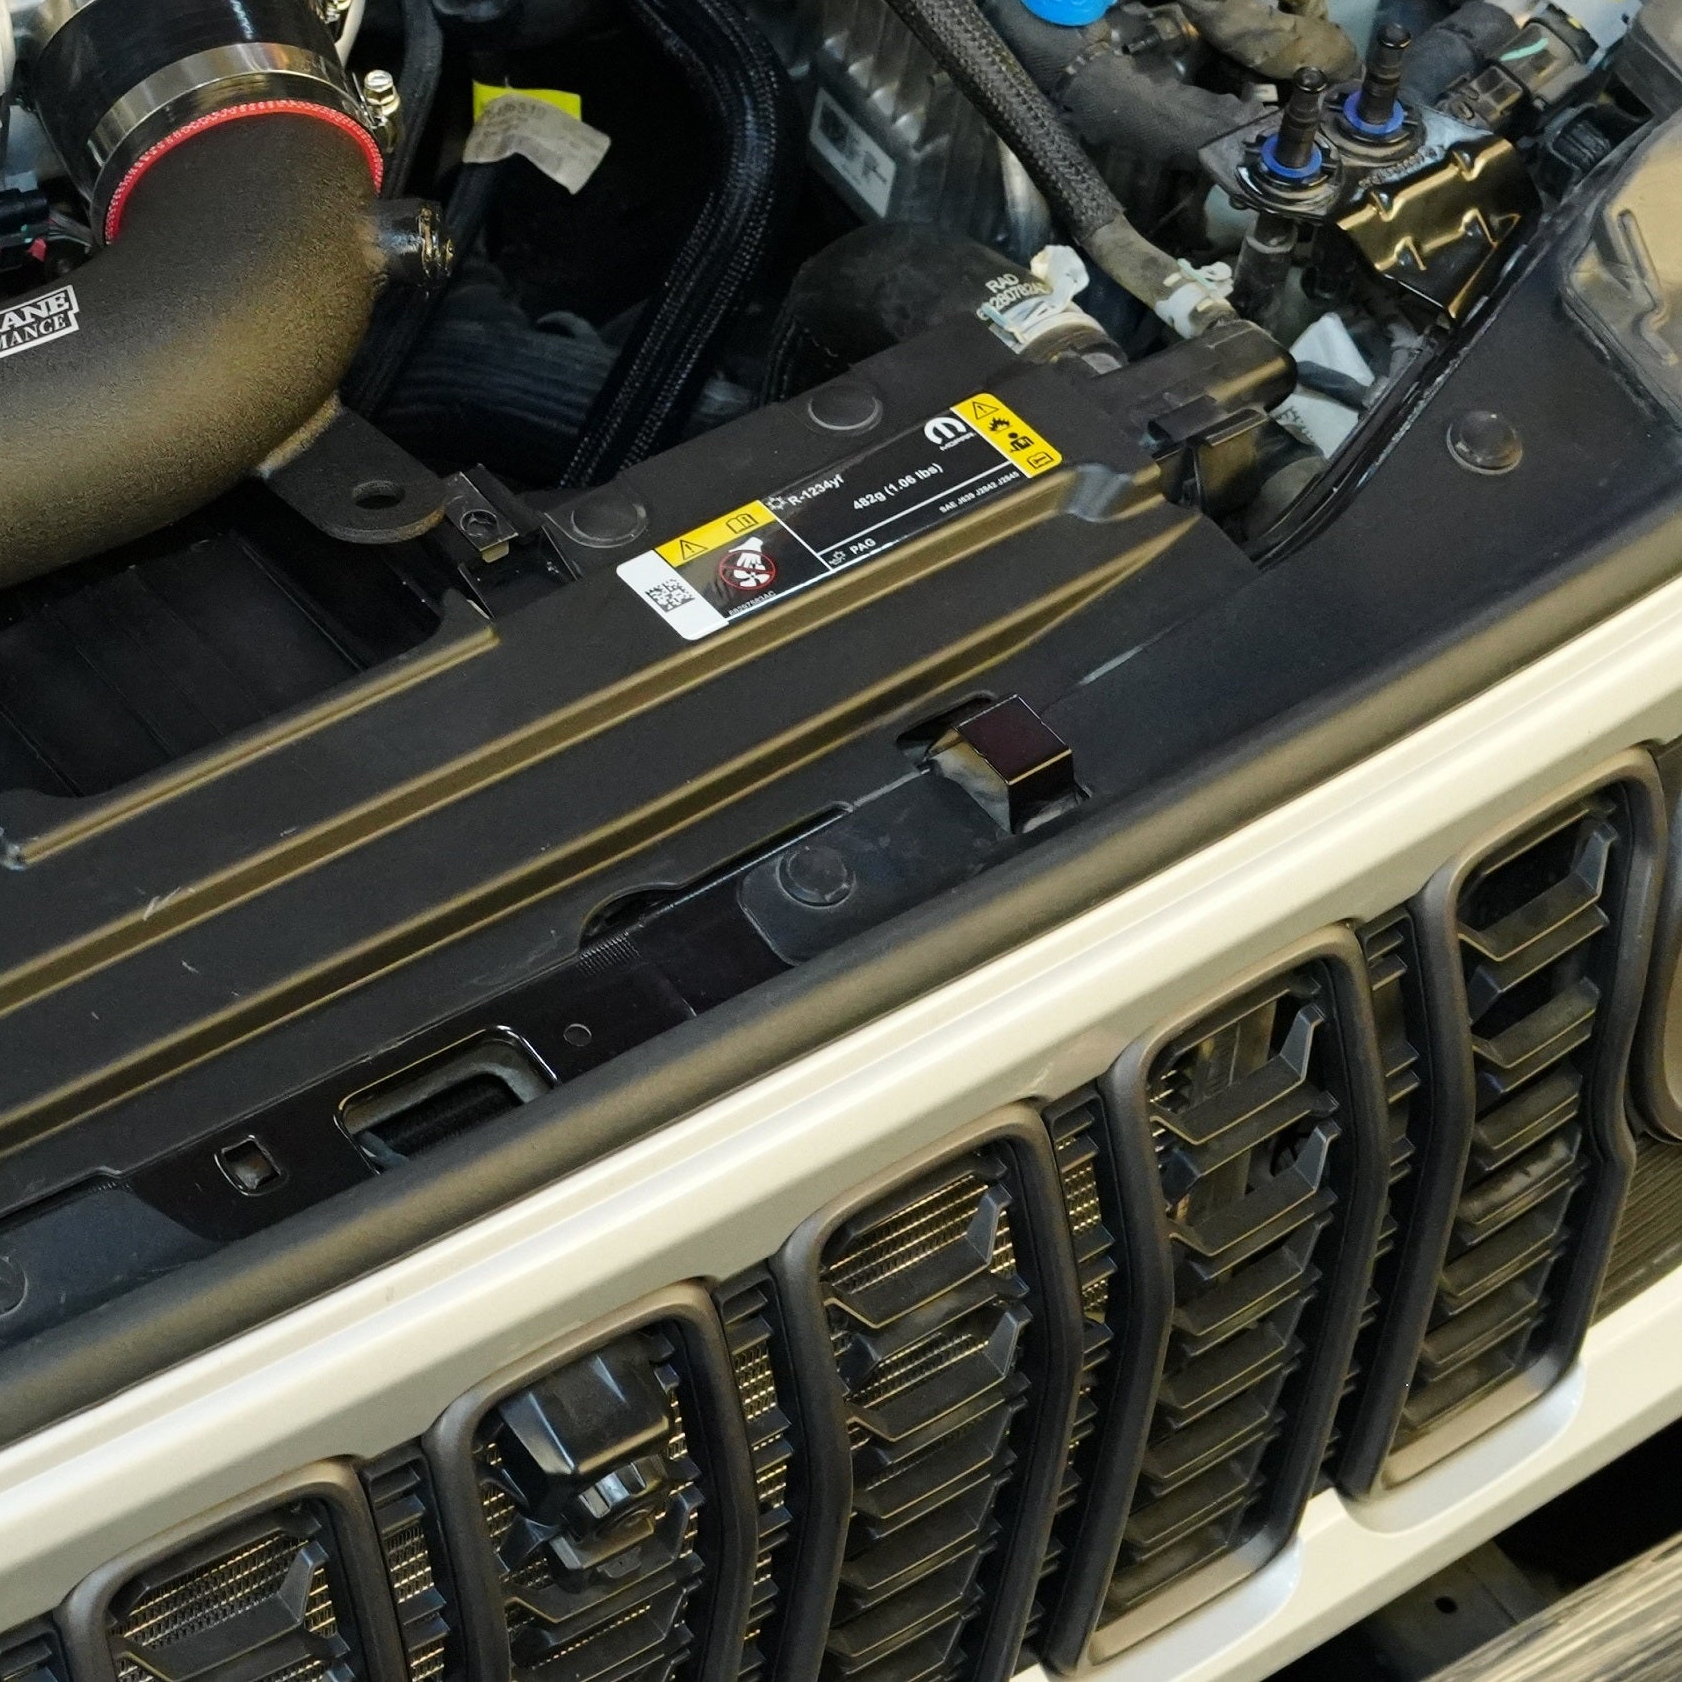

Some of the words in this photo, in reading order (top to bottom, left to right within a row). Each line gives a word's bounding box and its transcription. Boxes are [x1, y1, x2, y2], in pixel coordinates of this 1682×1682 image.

[985, 273, 1020, 294] RAD
[788, 474, 845, 508] R-1234yf
[852, 486, 889, 512] 482g
[883, 473, 918, 500] (1.06
[914, 461, 944, 490] lbs)
[849, 537, 876, 557] PAG
